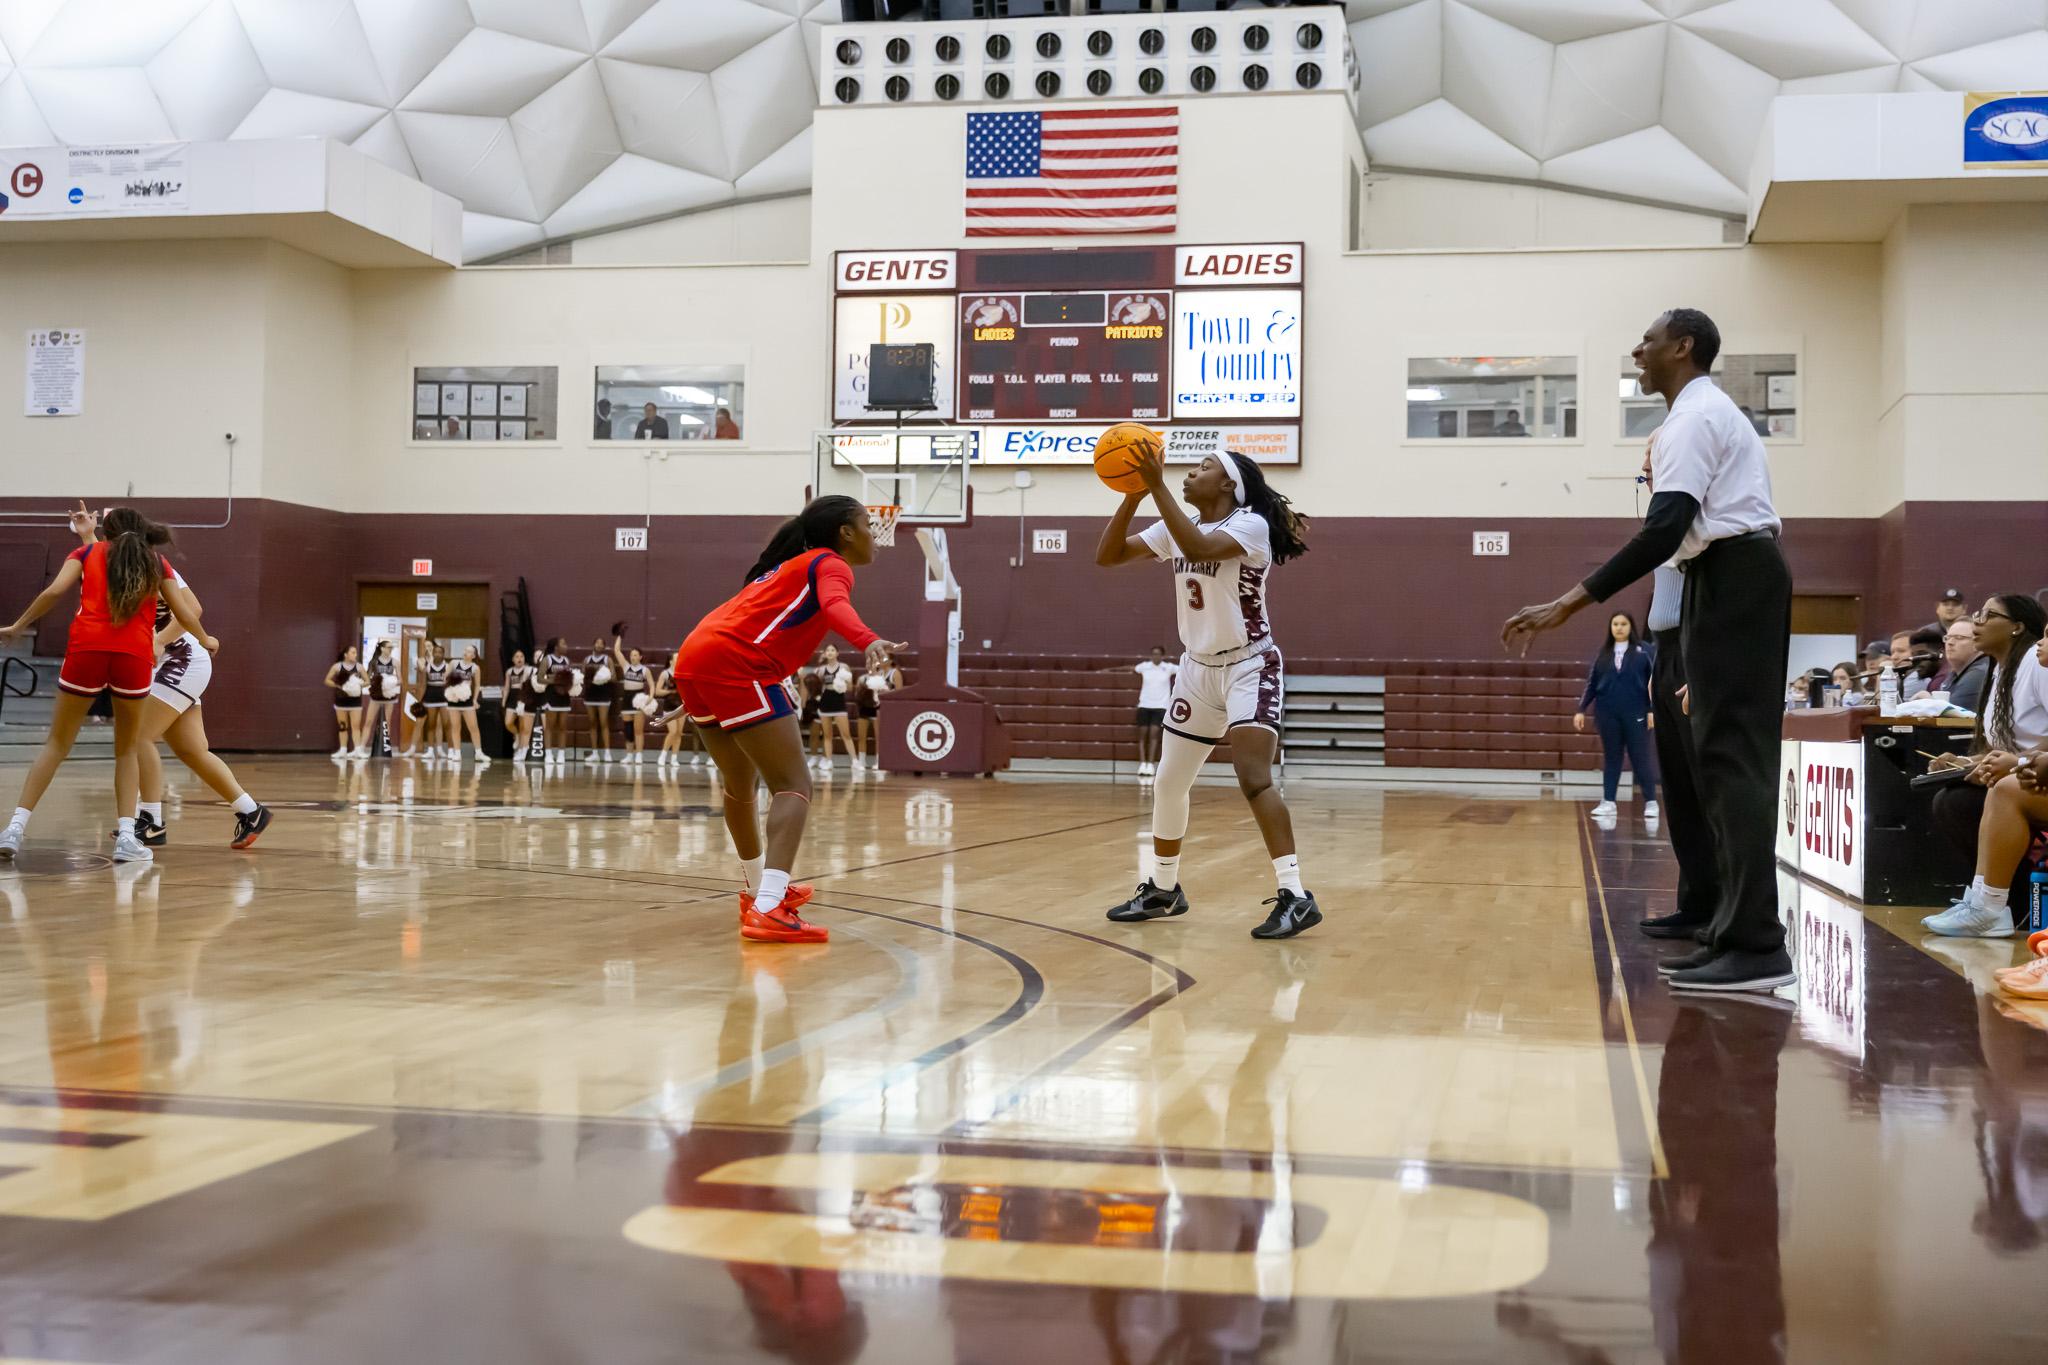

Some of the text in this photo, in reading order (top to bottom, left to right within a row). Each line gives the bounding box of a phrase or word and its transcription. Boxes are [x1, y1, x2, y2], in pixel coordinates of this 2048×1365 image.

[1990, 118, 2048, 138] SCAC
[17, 166, 38, 195] C
[845, 259, 949, 281] GENTS
[1184, 253, 1293, 276] LADIES
[974, 328, 1015, 341] LADIES
[1105, 325, 1163, 339] PATRIOTS
[1183, 309, 1295, 350] Town &
[1050, 337, 1079, 346] PERIOD
[1201, 348, 1297, 389] Country
[969, 374, 995, 384] FOULS
[1035, 374, 1092, 384] PLAYER FOUL
[1132, 373, 1158, 382] FOULS
[1180, 393, 1295, 403] CHRYSLER JEEP
[969, 409, 995, 419] SCORE
[1050, 409, 1076, 418] MATCH
[1132, 408, 1158, 418] SCORE
[1171, 431, 1219, 440] STORER
[1226, 433, 1287, 443] WE SUPPORT
[1004, 430, 1098, 459] Expres
[1168, 441, 1217, 451] Services
[1227, 445, 1287, 455] CENTENARY!
[621, 537, 642, 547] 107
[1039, 539, 1062, 550] 106
[1479, 541, 1503, 552] 105
[415, 562, 429, 574] EXIT
[1174, 557, 1222, 578] ENTENARY
[1186, 578, 1204, 612] 3
[1173, 701, 1188, 721] C
[911, 713, 951, 728] CENTENARY
[531, 725, 544, 758] CCLA
[919, 723, 942, 750] C
[1805, 763, 1854, 867] GENTS
[2032, 882, 2040, 927] POWERADE
